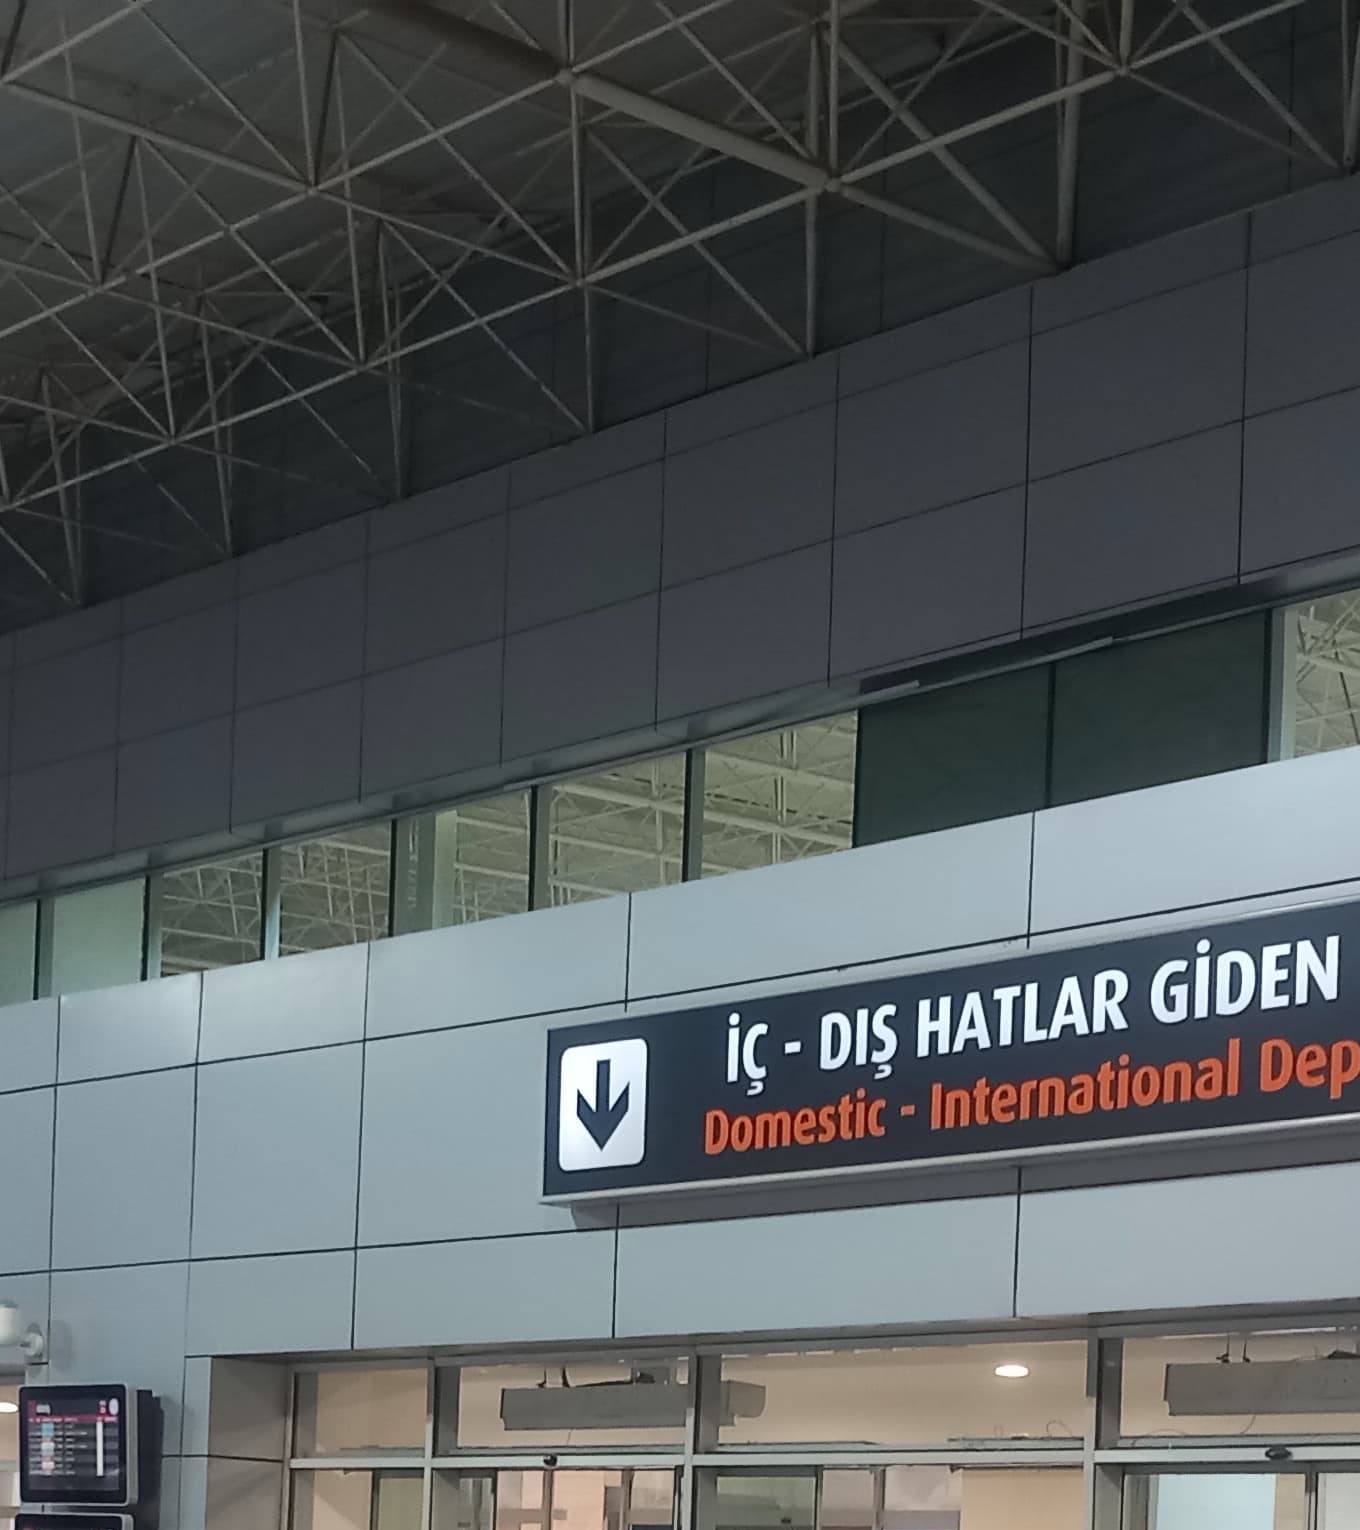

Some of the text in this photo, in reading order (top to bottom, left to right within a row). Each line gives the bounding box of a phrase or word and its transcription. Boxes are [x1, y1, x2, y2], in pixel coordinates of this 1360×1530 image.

[725, 1011, 769, 1096] İÇ
[819, 1003, 899, 1080] DIŞ
[915, 968, 1130, 1059] HATLAR
[1149, 938, 1340, 1025] GİDEN
[703, 1087, 886, 1156] Domestic
[930, 1037, 1241, 1131] International
